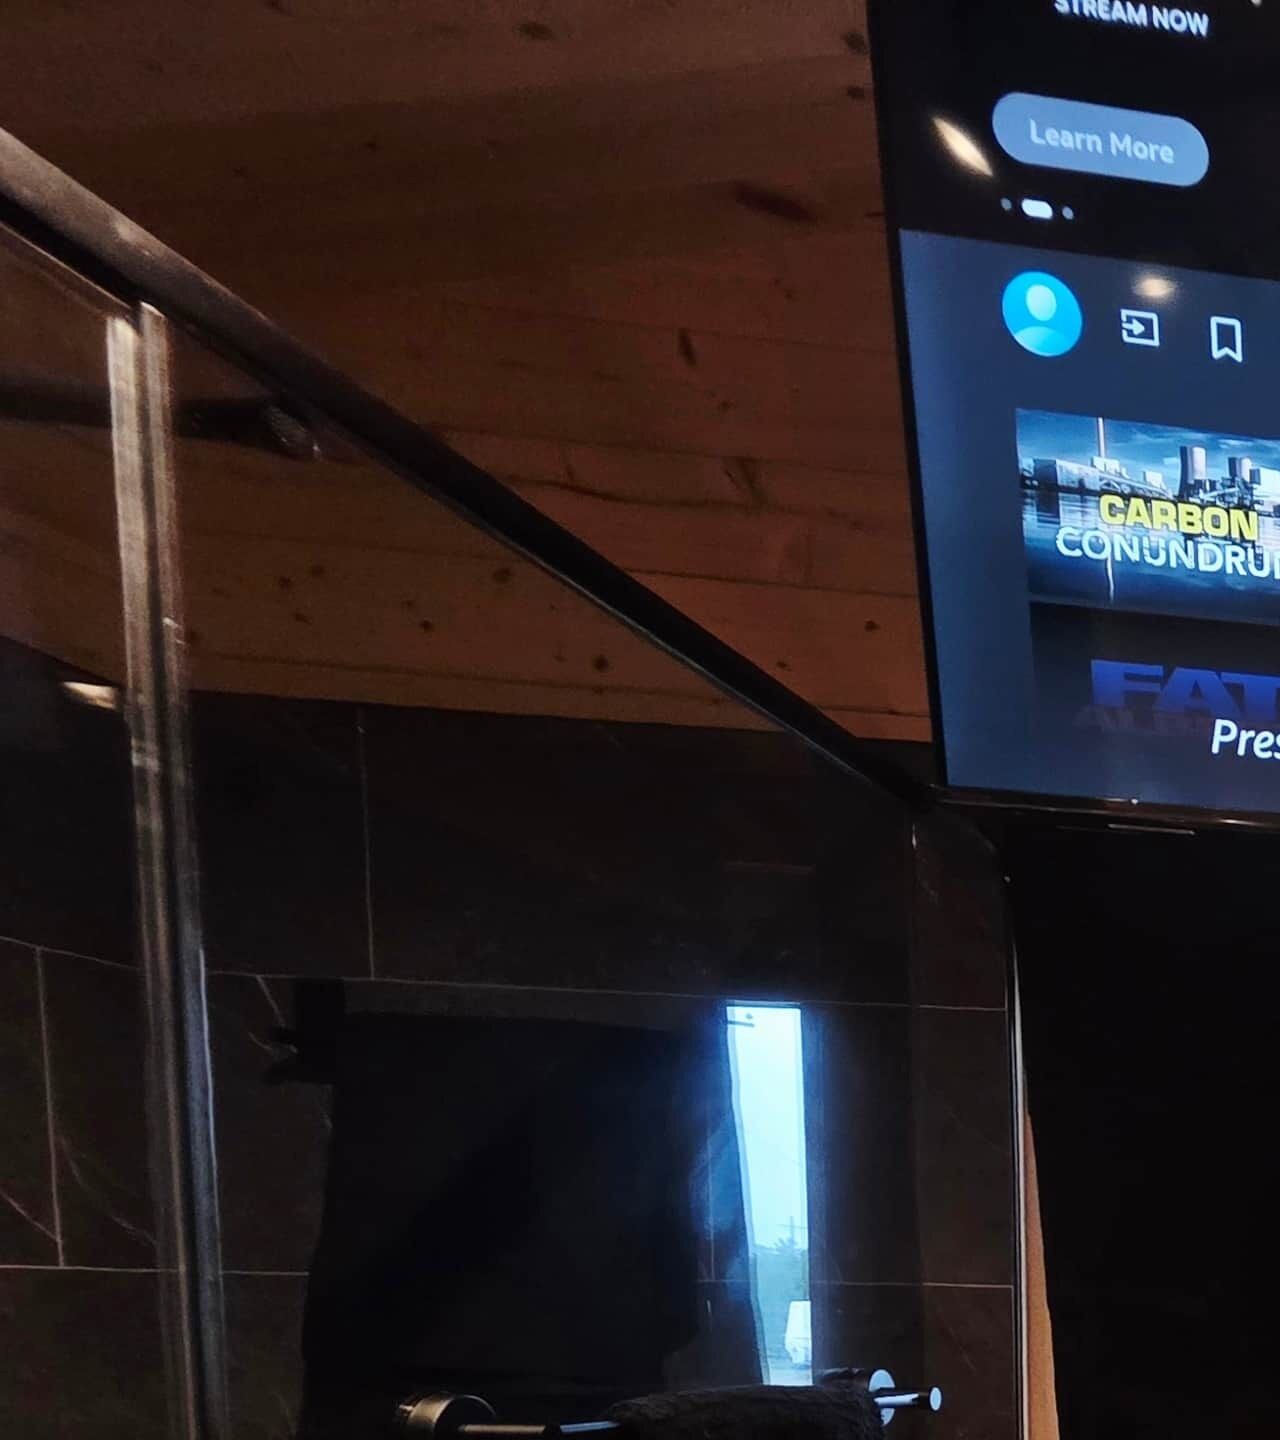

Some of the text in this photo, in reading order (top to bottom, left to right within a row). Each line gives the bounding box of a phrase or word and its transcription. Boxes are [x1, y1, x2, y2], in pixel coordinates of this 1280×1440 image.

[1054, 0, 1209, 37] STREAM NOW
[1029, 119, 1175, 165] Learn More
[1098, 494, 1260, 543] CARBON
